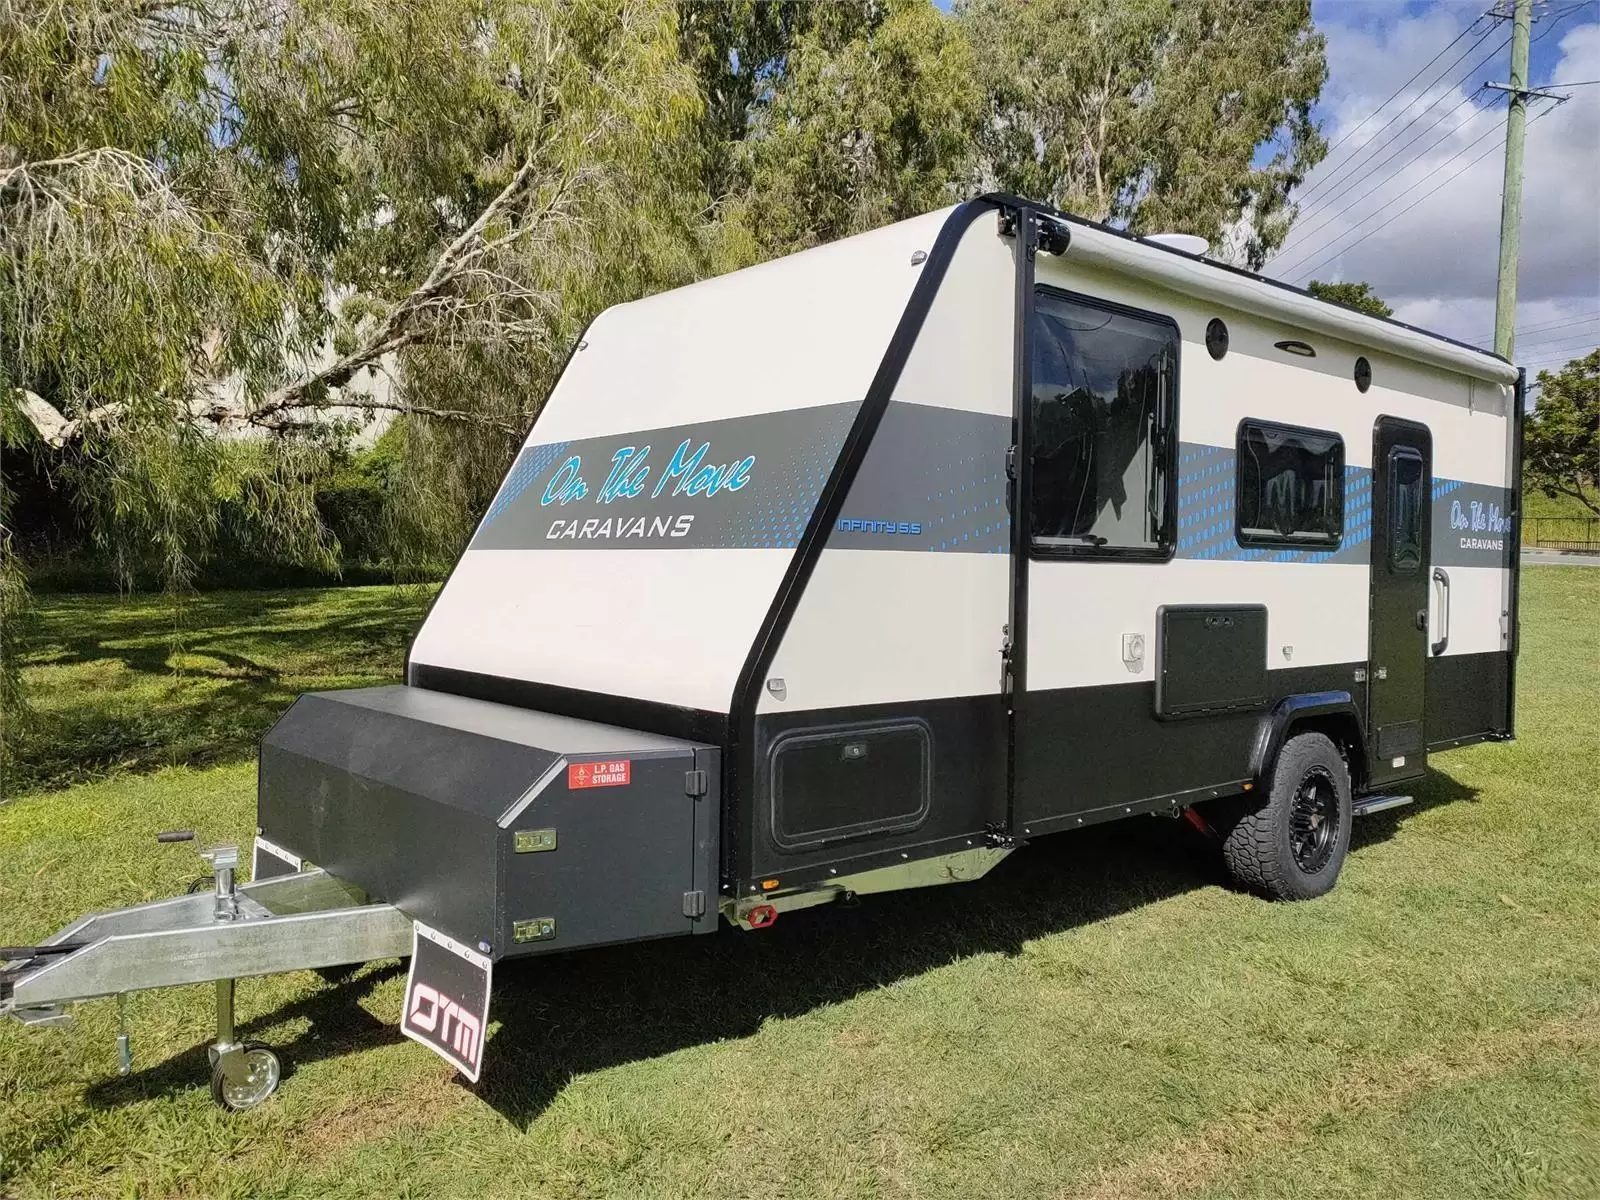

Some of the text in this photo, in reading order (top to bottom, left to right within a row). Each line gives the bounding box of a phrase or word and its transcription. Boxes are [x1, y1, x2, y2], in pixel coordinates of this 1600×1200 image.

[540, 438, 755, 506] On The Move
[1450, 500, 1468, 530] On
[1470, 501, 1486, 532] The
[546, 514, 694, 540] CARAVANS
[838, 519, 896, 534] INFINITY
[1460, 537, 1504, 551] CARAVANS
[609, 763, 625, 773] GAS
[592, 773, 626, 784] STORAGE
